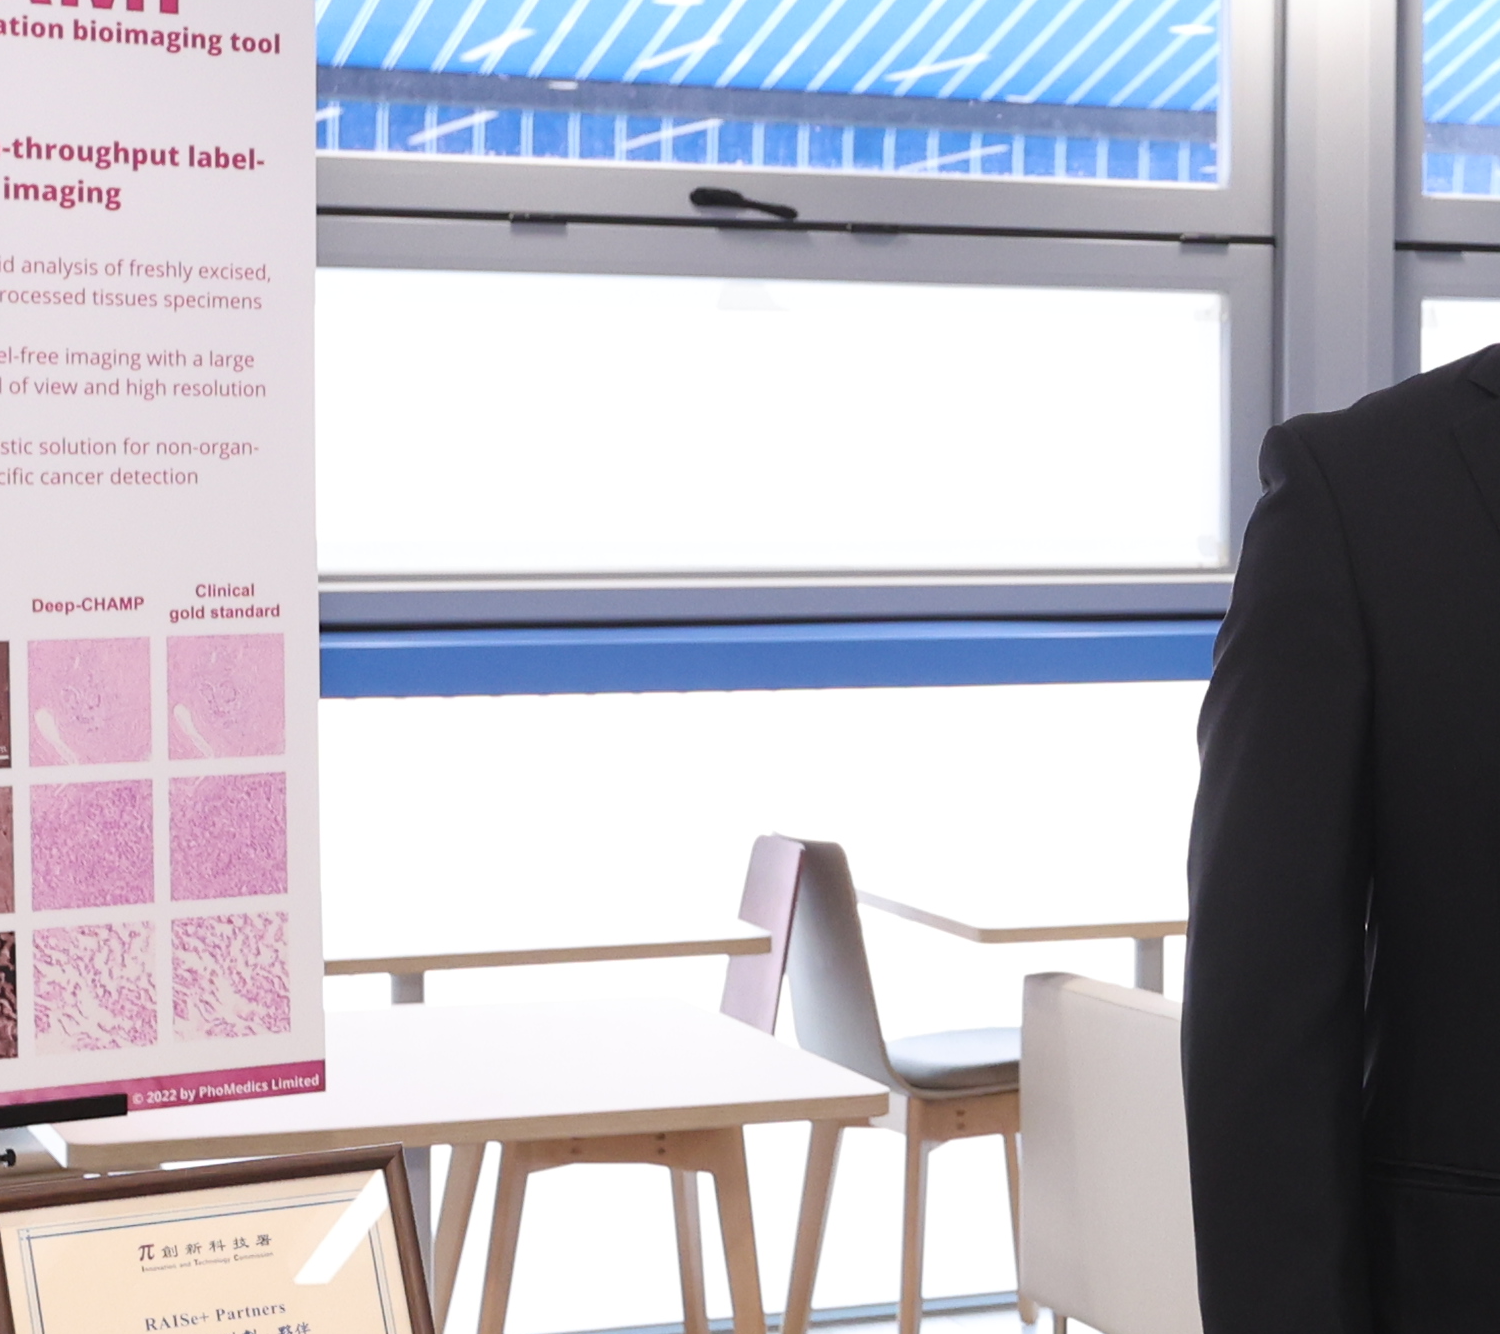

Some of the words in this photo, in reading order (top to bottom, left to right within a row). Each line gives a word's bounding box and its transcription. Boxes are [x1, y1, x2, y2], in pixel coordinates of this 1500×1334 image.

[73, 18, 223, 56] bioimaging
[230, 33, 280, 54] tool
[189, 145, 265, 170] label-
[4, 176, 122, 210] imaging
[22, 256, 98, 280] analysis
[105, 259, 125, 277] of
[130, 260, 193, 283] freshly
[199, 264, 271, 283] excised,
[93, 289, 157, 307] tissues
[164, 293, 262, 313] specimens
[65, 348, 141, 370] imaging
[147, 350, 186, 367] with
[193, 354, 202, 367] a
[210, 351, 254, 372] large
[9, 377, 30, 395] of
[35, 379, 77, 396] view
[84, 378, 119, 396] and
[127, 378, 166, 400] high
[173, 380, 266, 397] resolution
[39, 437, 116, 456] solution
[123, 437, 150, 456] for
[156, 440, 259, 460] non-organ-
[41, 470, 103, 485] cancer
[110, 467, 198, 485] detection
[196, 583, 255, 599] Clinical
[32, 597, 145, 615] Deep-CHAMP
[169, 606, 205, 622] gold
[211, 604, 280, 620] standard
[147, 1092, 177, 1104] 2022
[180, 1088, 196, 1102] by
[199, 1081, 268, 1098] PhoMedics
[271, 1074, 319, 1090] Limited
[162, 1234, 272, 1258] 創新科技署
[145, 1312, 210, 1332] RAISe+
[216, 1303, 286, 1322] Partners
